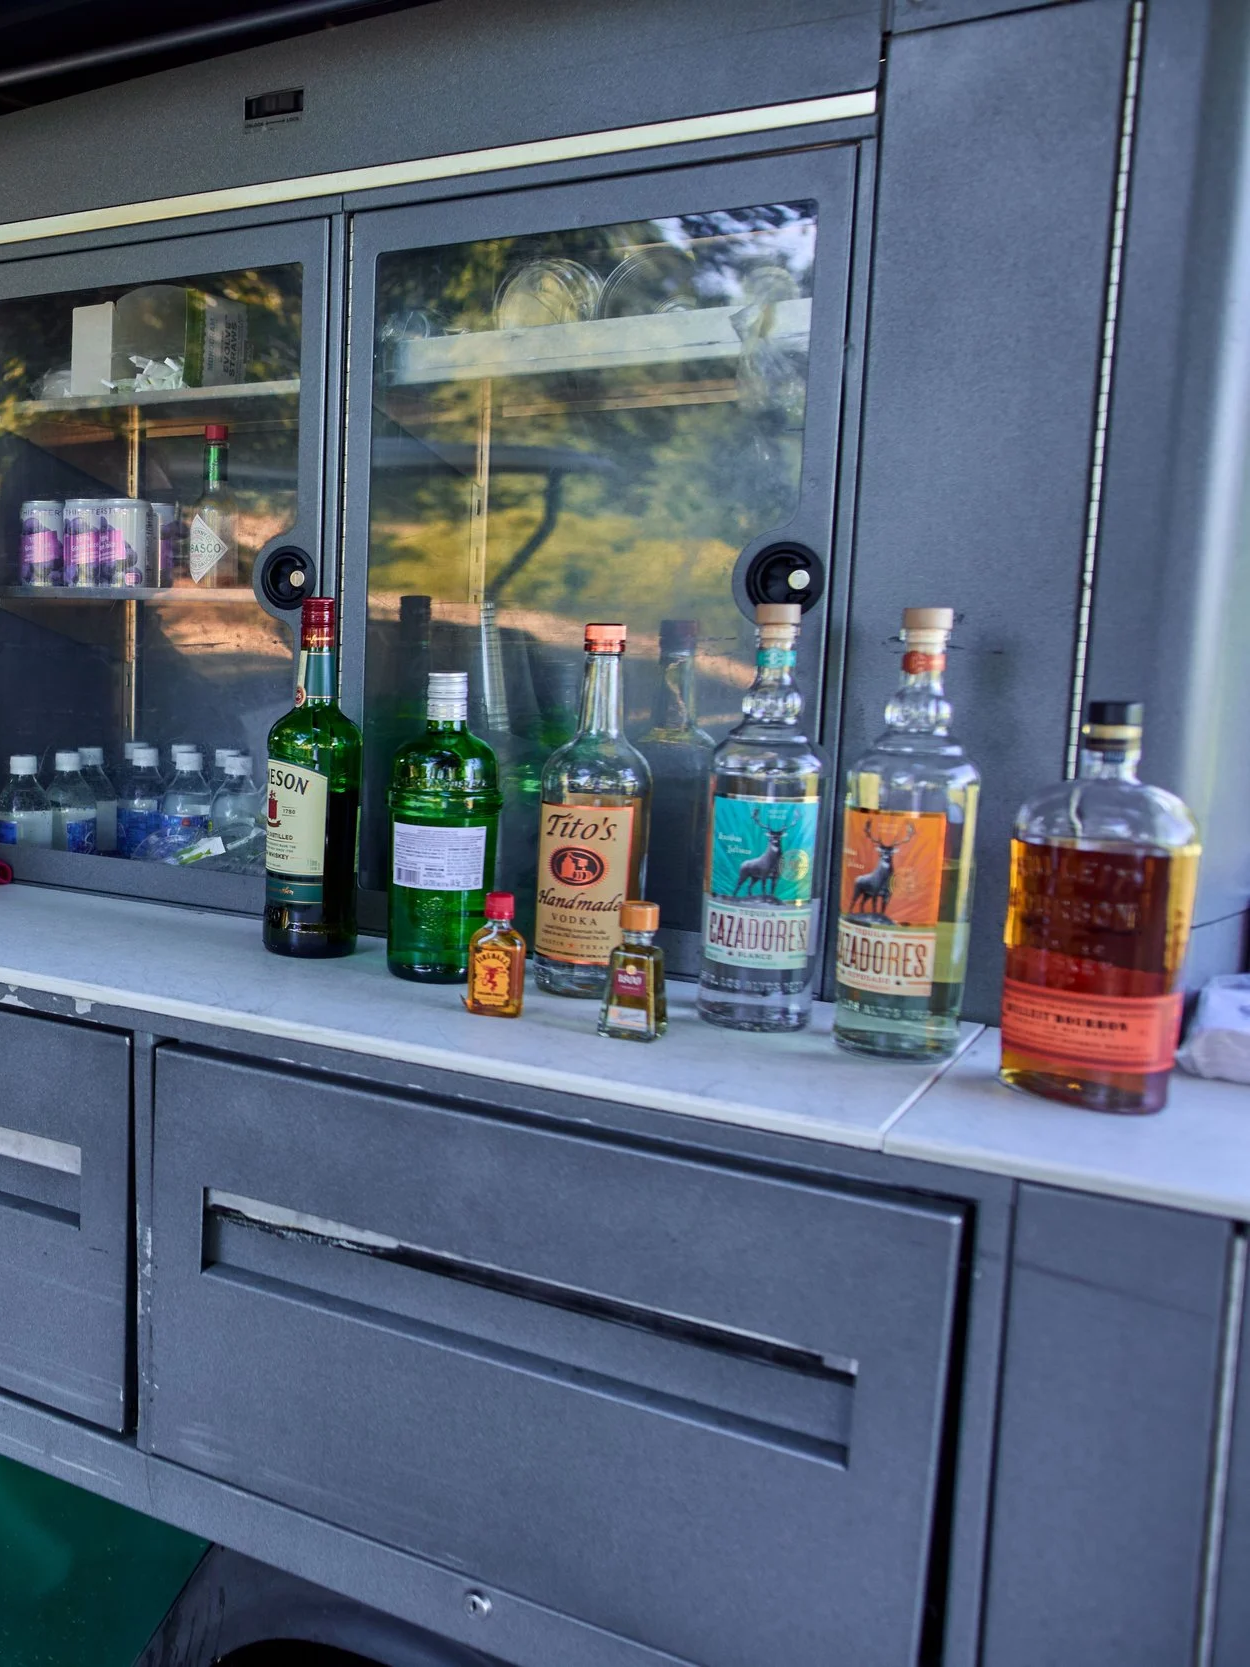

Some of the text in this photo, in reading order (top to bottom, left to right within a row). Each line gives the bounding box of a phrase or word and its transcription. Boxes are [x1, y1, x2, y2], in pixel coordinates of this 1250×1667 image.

[207, 318, 216, 371] MONOGRAM
[223, 322, 232, 374] EVOLVE
[229, 321, 238, 377] STRAWS
[190, 543, 221, 554] BASCO
[268, 768, 310, 796] ESON
[546, 812, 617, 842] Tito's
[538, 887, 623, 912] Handmade
[738, 908, 777, 917] TEQUILA
[551, 913, 598, 926] VODKA
[709, 911, 808, 952] CAZADORES
[737, 951, 773, 960] BLANCO
[837, 930, 927, 978] AZADORES
[1055, 1014, 1128, 1032] BOURBON
